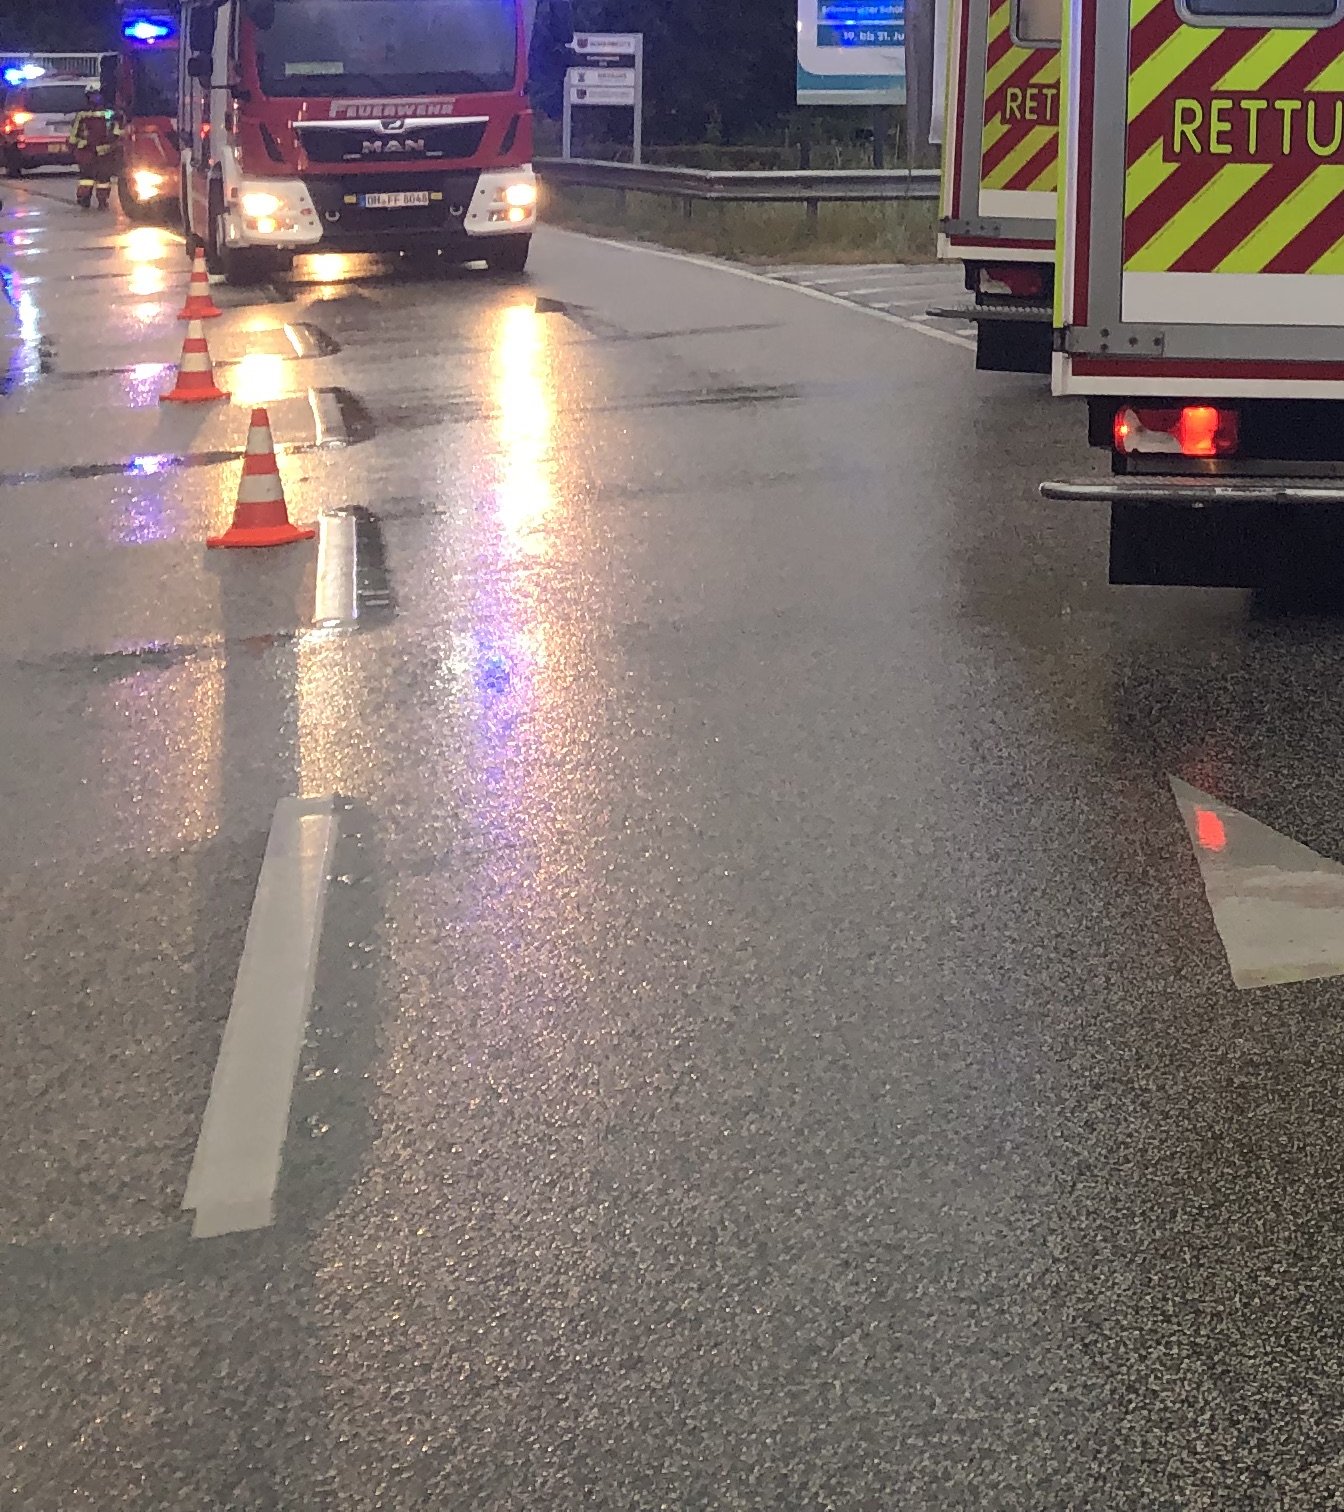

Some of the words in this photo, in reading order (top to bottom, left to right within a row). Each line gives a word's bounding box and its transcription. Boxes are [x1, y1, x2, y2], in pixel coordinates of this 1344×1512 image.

[328, 98, 456, 118] FEUERWEHR
[1005, 87, 1058, 121] RET
[362, 139, 425, 154] MAN
